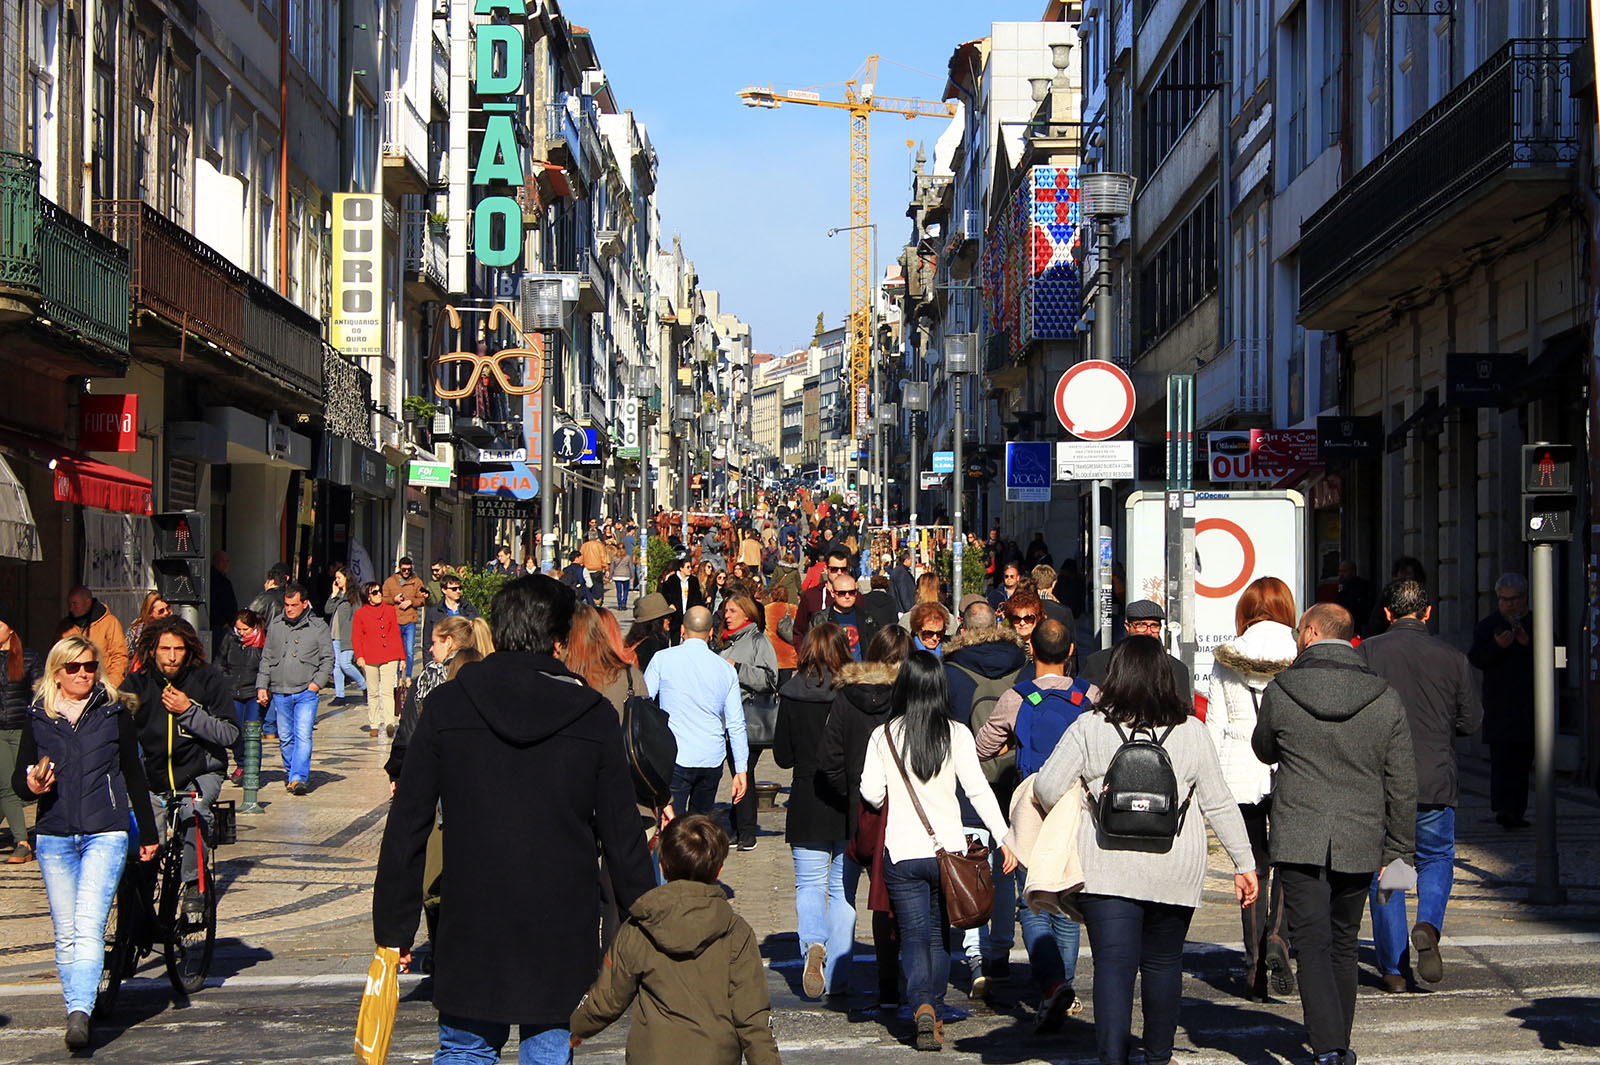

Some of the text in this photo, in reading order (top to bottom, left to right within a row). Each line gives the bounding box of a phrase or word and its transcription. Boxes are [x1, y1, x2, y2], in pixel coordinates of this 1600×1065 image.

[343, 197, 373, 313] OURO
[626, 388, 636, 445] OTO
[460, 473, 532, 490] FIDÉLIA
[1012, 474, 1046, 484] YOGA
[1196, 492, 1230, 500] JCDecaux
[477, 500, 516, 509] BAZAR
[476, 507, 529, 518] MABRIL
[1206, 634, 1211, 642] E
